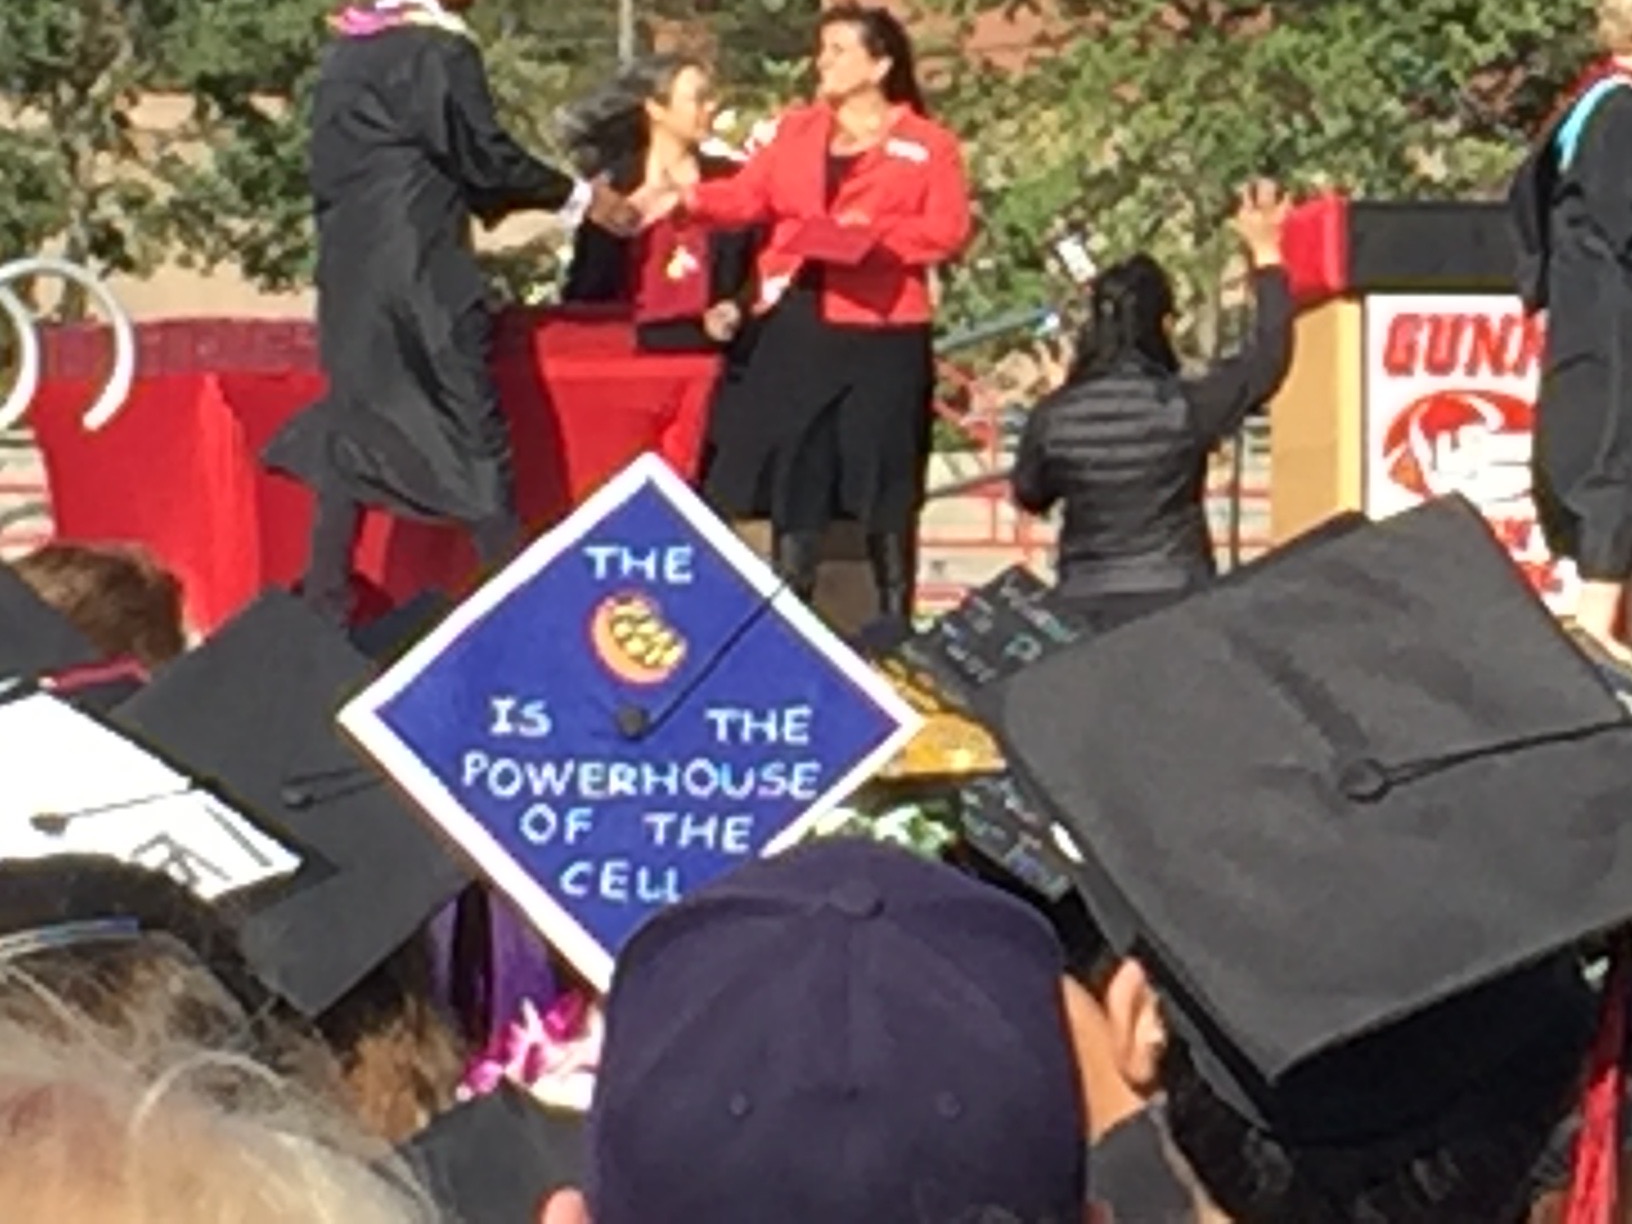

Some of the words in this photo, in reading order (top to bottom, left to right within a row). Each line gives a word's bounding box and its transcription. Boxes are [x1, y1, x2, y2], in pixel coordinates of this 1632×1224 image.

[583, 545, 695, 584] THE
[489, 696, 551, 737] IS
[705, 706, 813, 745] THE
[462, 752, 821, 801] POWERHOUSE
[520, 804, 593, 845] OF
[643, 811, 754, 854] THE
[559, 860, 683, 905] CELL
